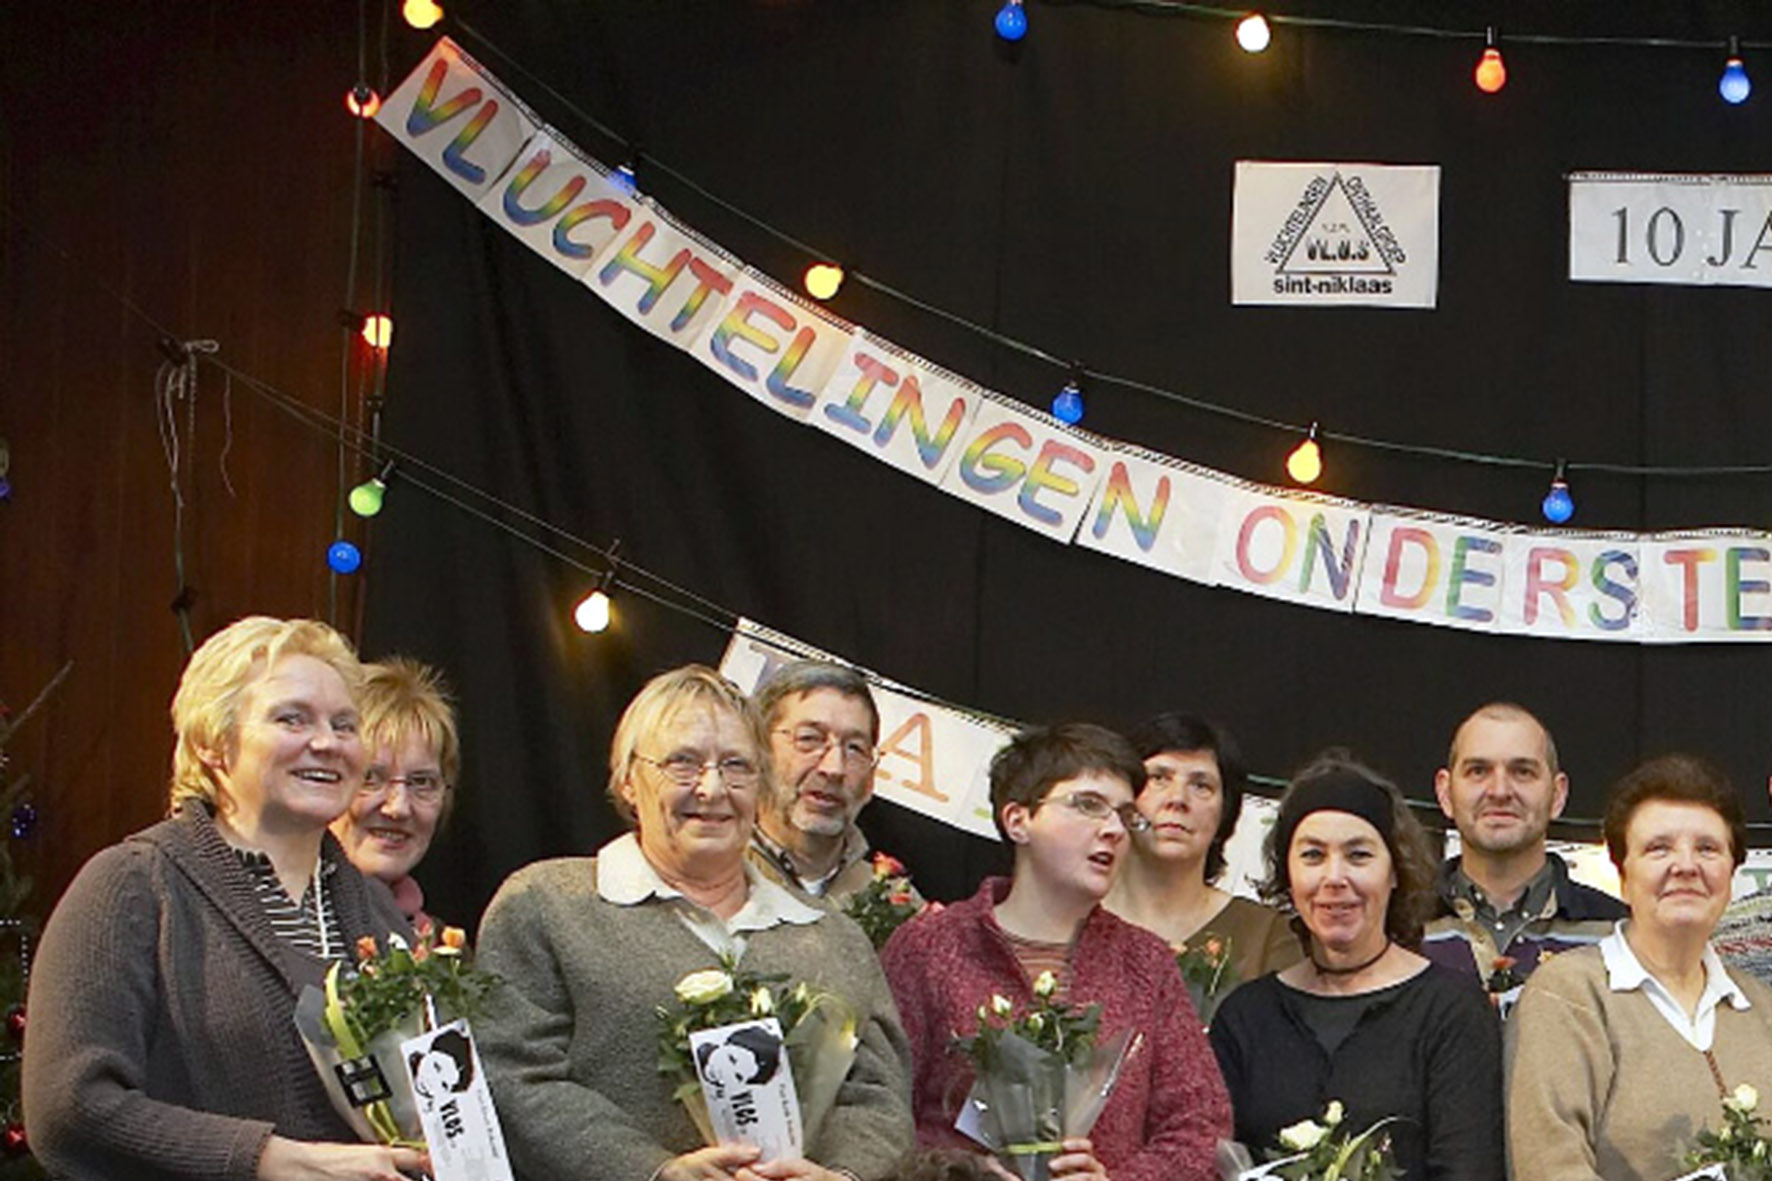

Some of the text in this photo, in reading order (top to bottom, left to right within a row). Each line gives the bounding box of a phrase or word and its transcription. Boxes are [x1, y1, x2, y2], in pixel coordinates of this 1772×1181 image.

[1612, 205, 1684, 270] 10
[405, 57, 1172, 552] VLUCHTELINGEN
[1273, 275, 1394, 294] sint-niklaas
